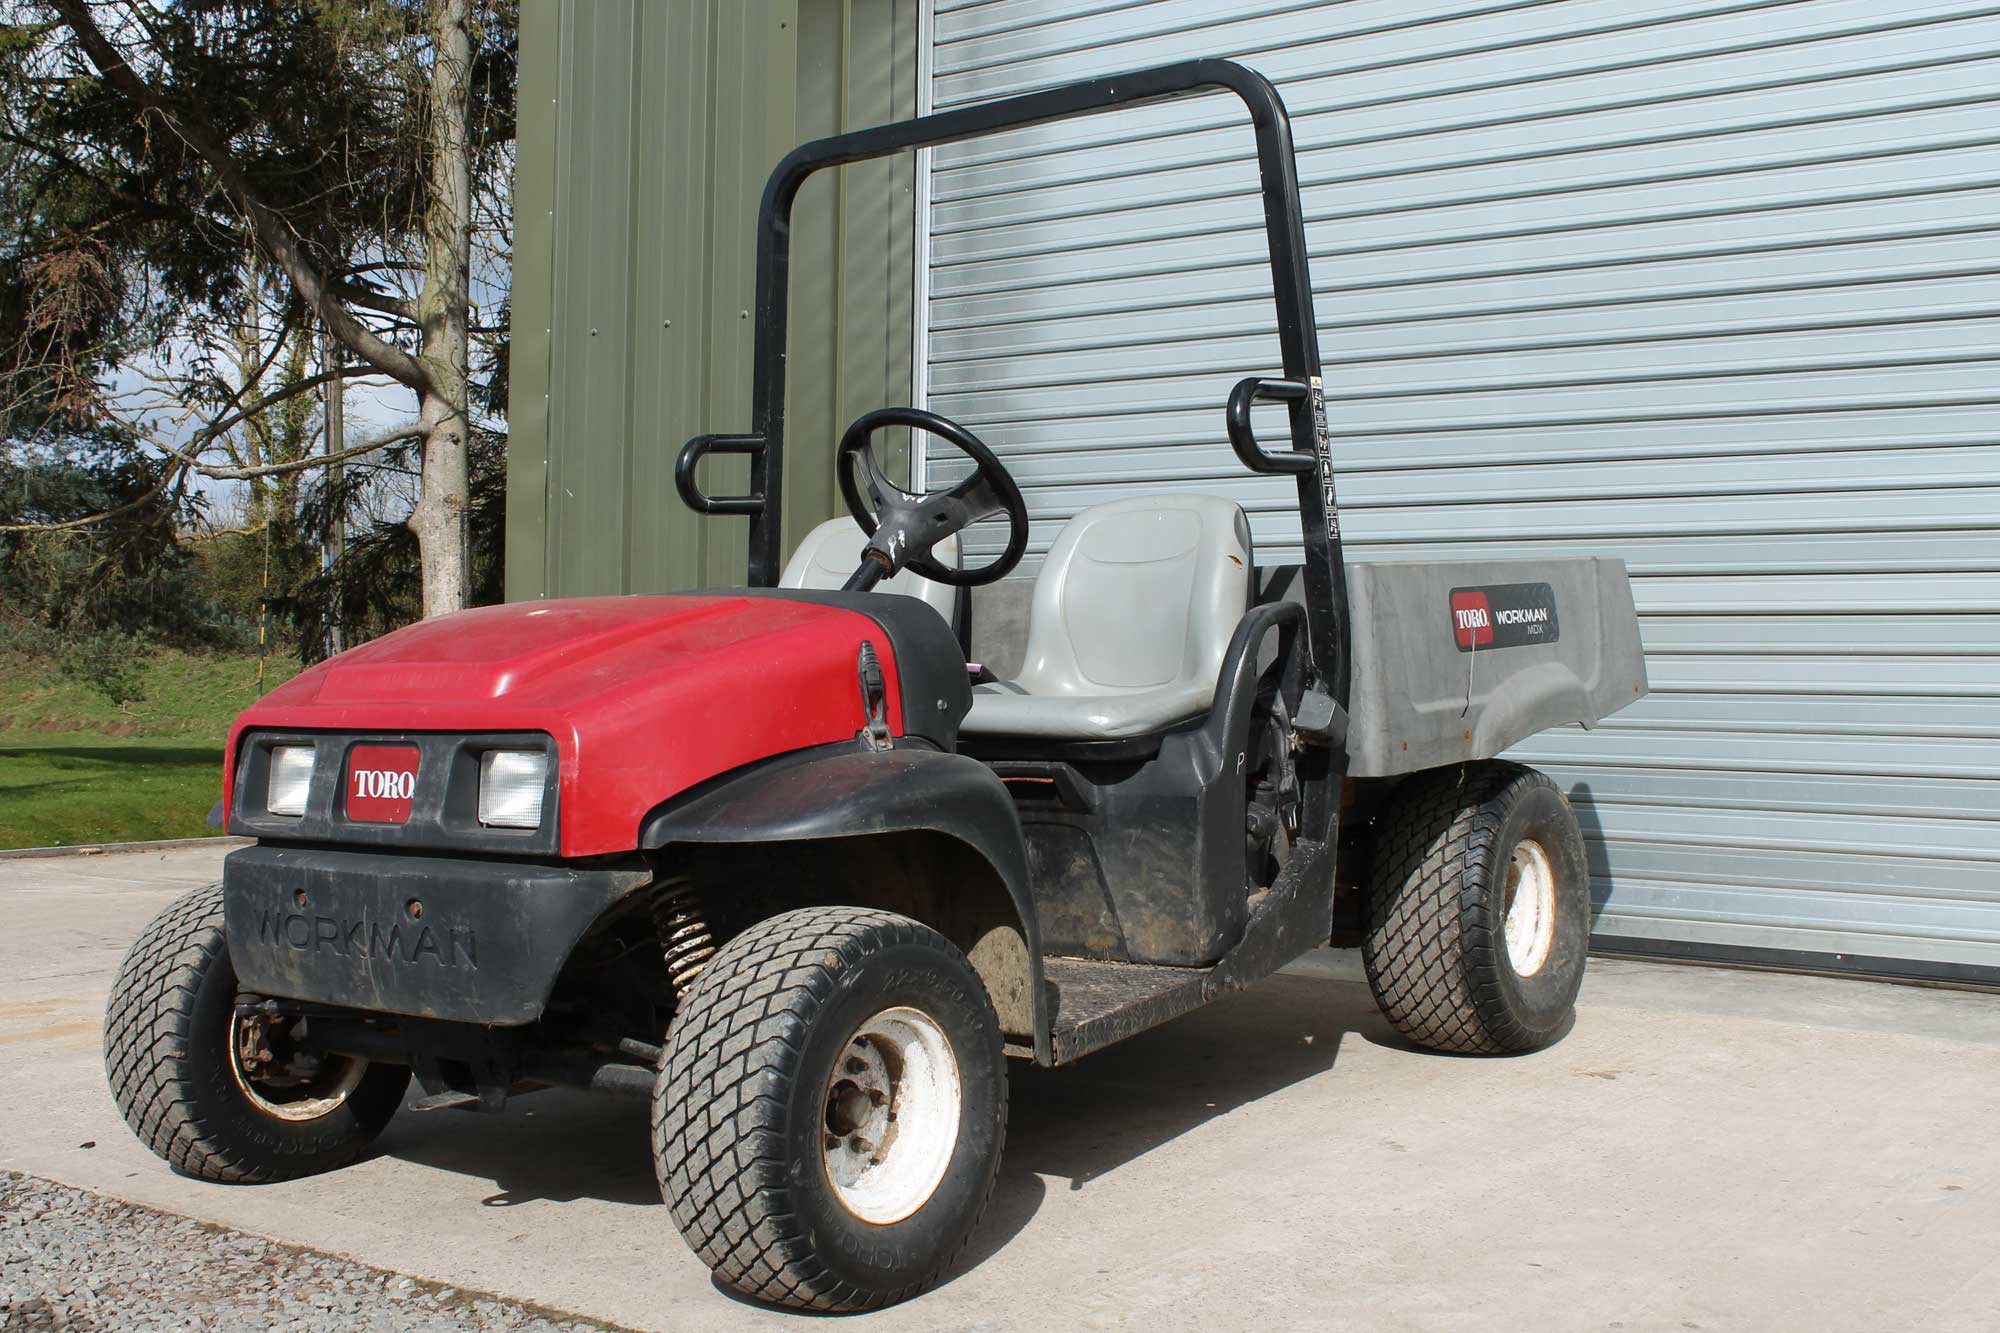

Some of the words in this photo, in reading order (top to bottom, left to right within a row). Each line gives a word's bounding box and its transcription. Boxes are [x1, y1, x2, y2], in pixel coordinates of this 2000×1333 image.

[1456, 608, 1488, 629] TORO
[1496, 608, 1548, 625] WORKMAN
[1527, 624, 1544, 635] MDX
[354, 769, 415, 799] TORO
[254, 908, 478, 971] WORKMAN
